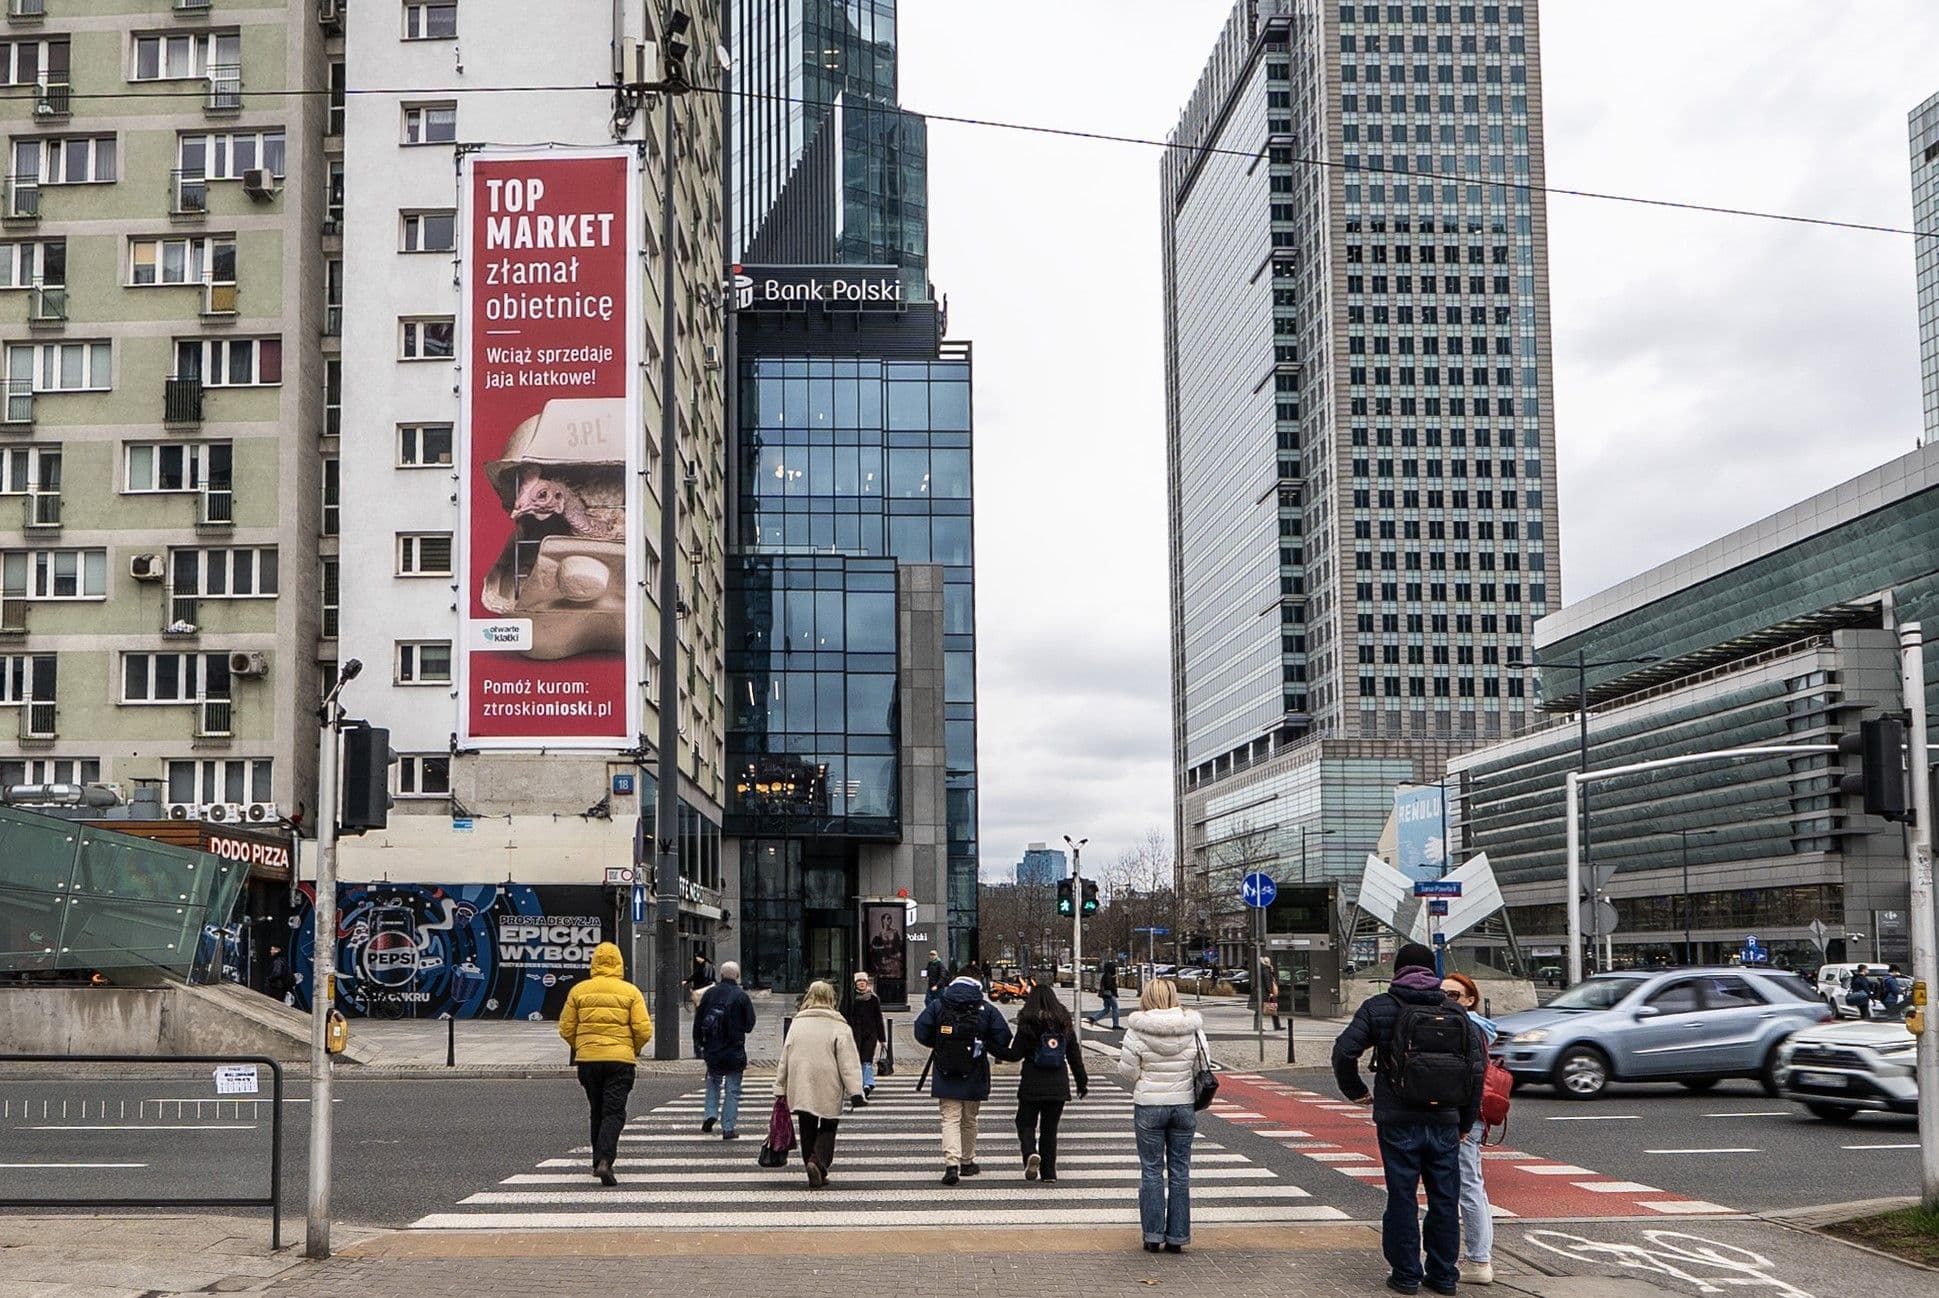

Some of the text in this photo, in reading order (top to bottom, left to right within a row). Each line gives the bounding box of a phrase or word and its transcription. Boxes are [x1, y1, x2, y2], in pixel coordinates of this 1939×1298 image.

[486, 178, 544, 213] TOP
[486, 213, 614, 250] MARKET
[486, 256, 579, 285] złamał
[765, 279, 823, 301] Bank
[833, 279, 900, 301] Polski
[486, 292, 613, 321] obietnicę
[486, 345, 613, 366] Wciąż sprzedaje
[485, 368, 596, 390] jaja klatkowe!
[490, 625, 519, 633] otwarte
[494, 634, 519, 642] klatki
[483, 679, 590, 695] Pomóż kurom:
[483, 700, 613, 718] ztroskionioski.pl
[618, 779, 629, 790] 18
[211, 837, 289, 868] DODO PIZZA
[499, 915, 602, 927] PROSTA DECYZJA
[499, 926, 602, 944] EPICKI
[367, 952, 416, 965] PEPSI
